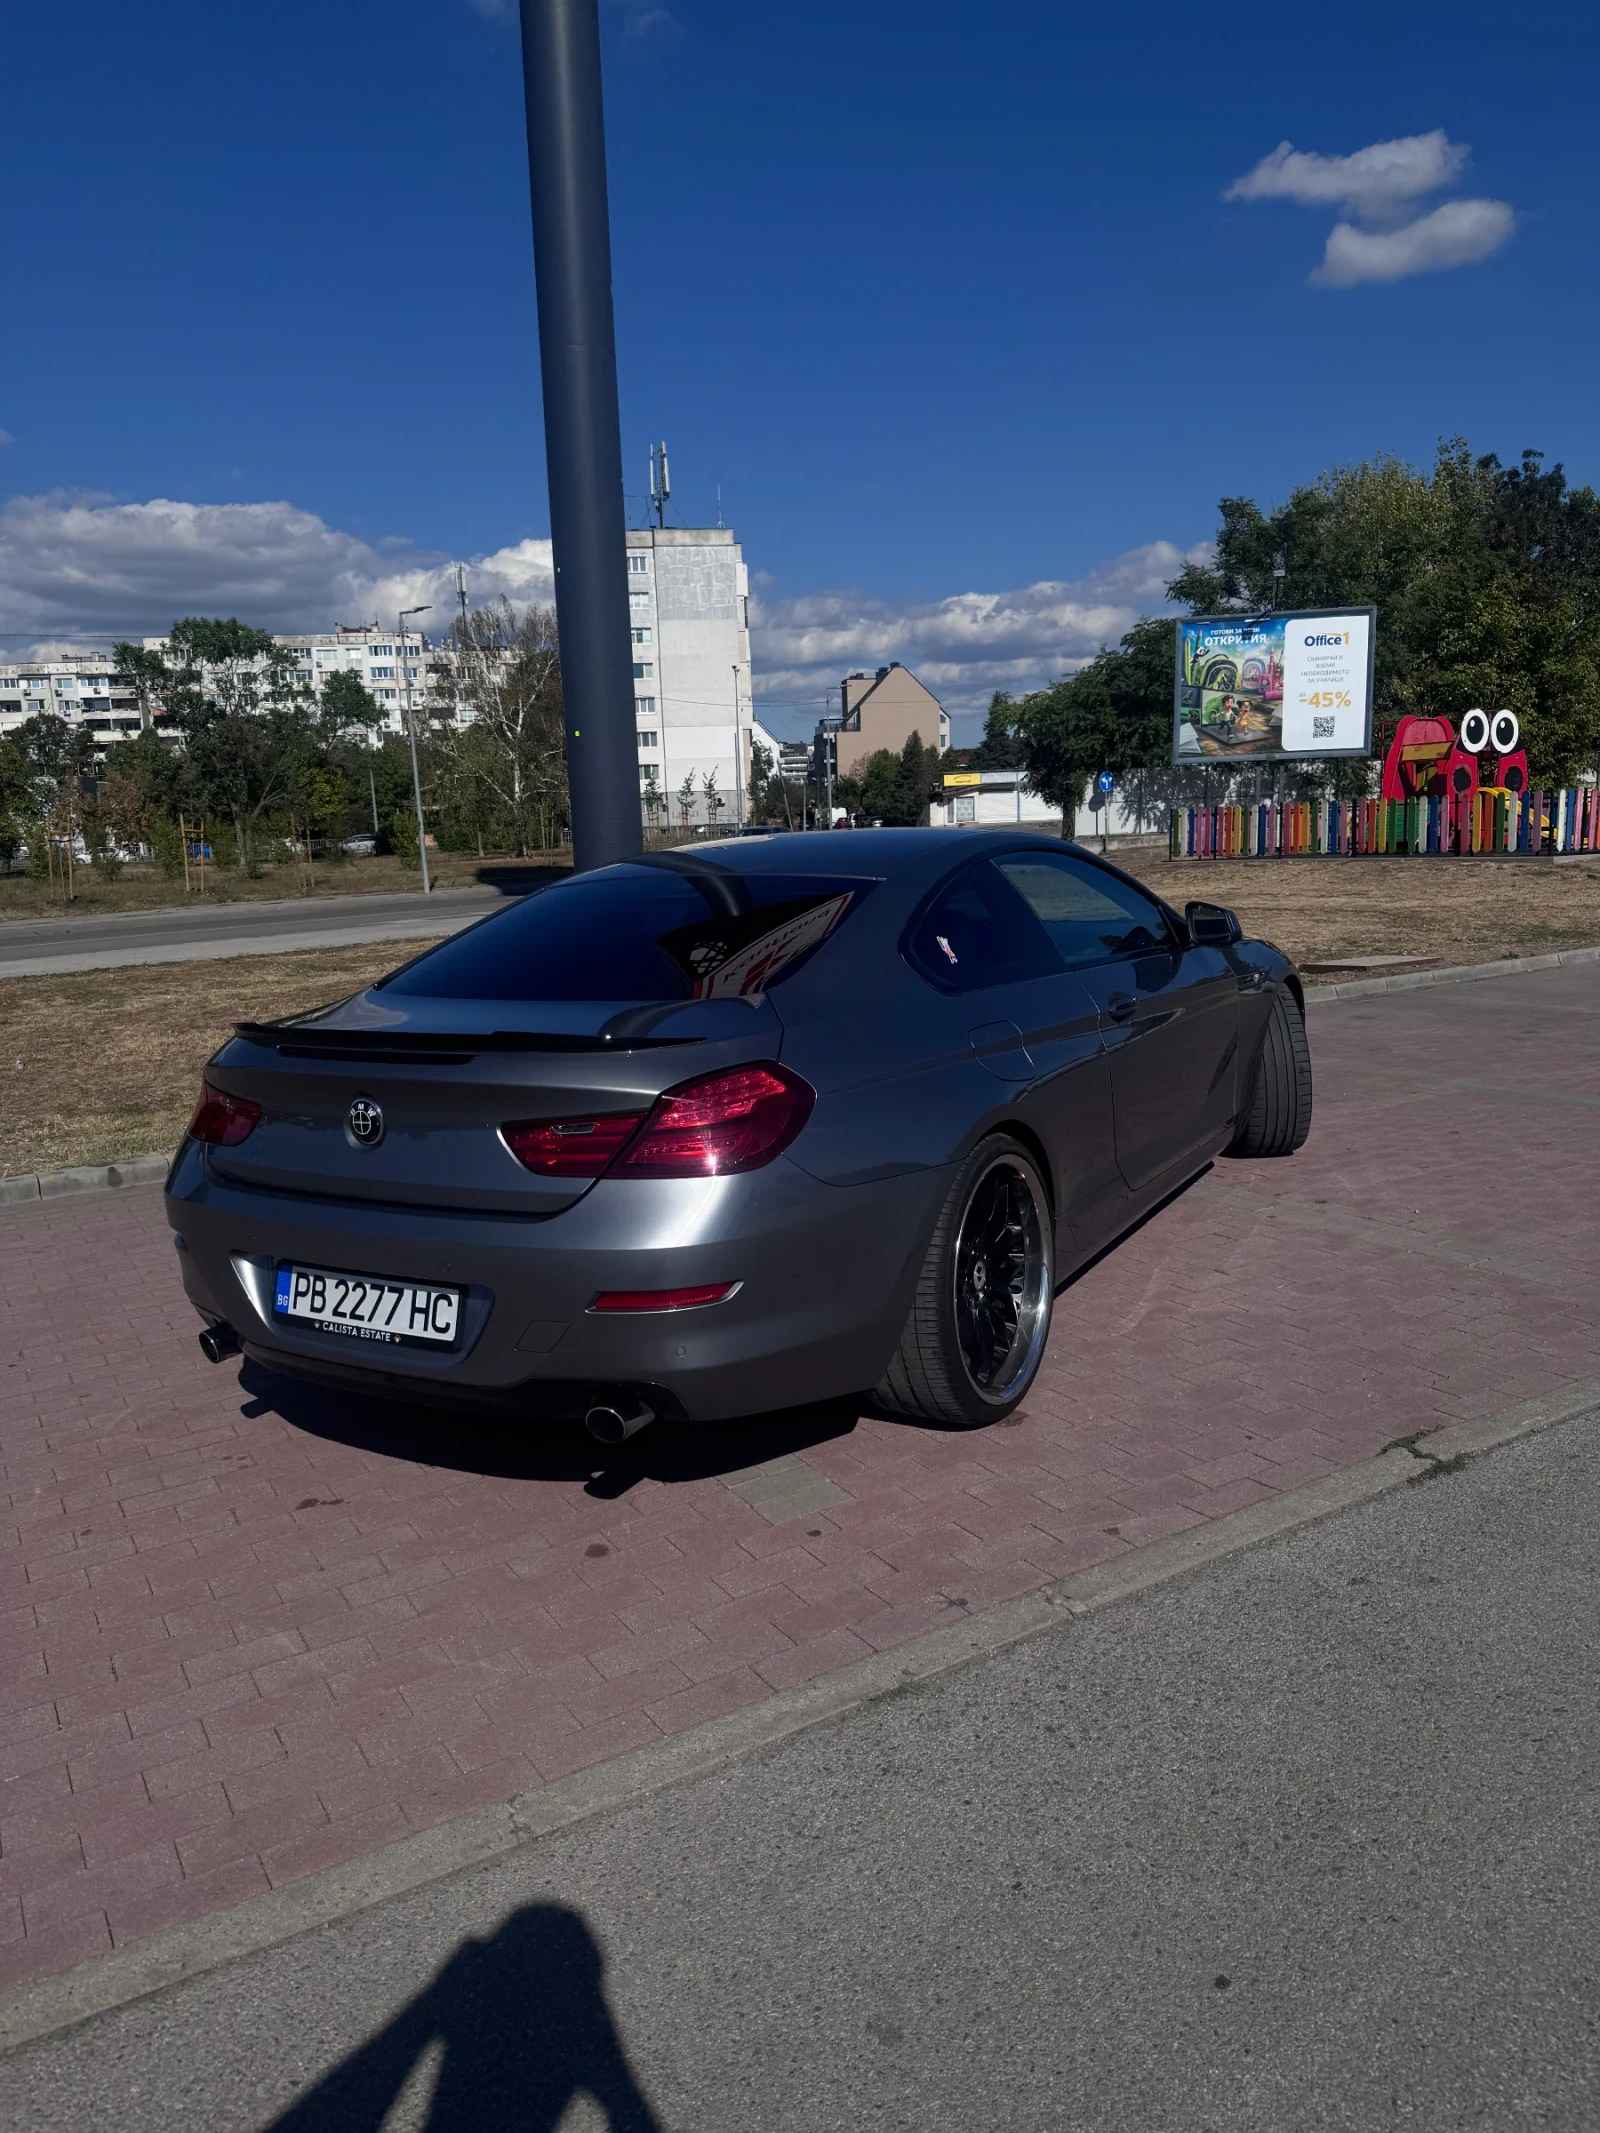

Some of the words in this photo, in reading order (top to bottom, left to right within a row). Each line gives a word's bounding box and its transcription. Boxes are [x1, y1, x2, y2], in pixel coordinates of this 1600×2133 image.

[1299, 690, 1351, 708] -45%
[277, 1294, 289, 1307] BG
[292, 1271, 327, 1314] PB
[332, 1279, 405, 1326] 2277
[408, 1290, 453, 1334] HC
[322, 1322, 358, 1337] CALISTA
[360, 1328, 391, 1342] ESTATE
